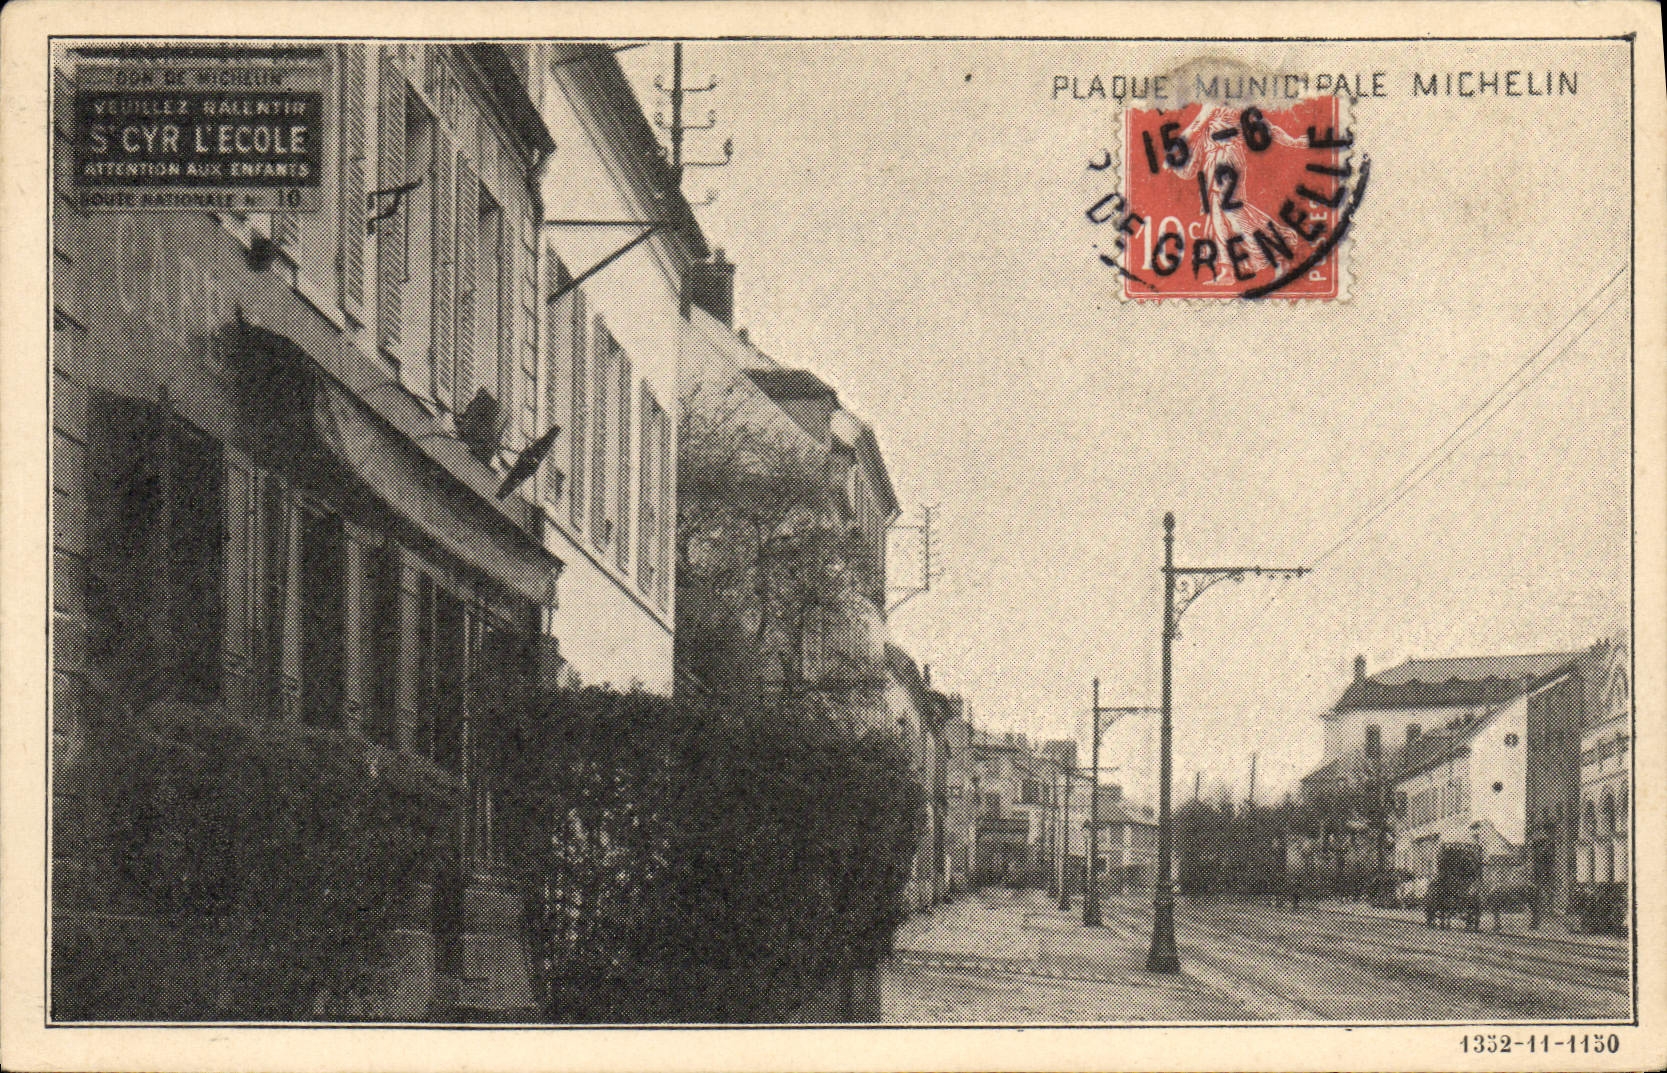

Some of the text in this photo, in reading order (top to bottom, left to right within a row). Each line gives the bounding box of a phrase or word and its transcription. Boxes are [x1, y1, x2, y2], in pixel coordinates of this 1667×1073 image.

[198, 70, 282, 86] MICHELIN
[93, 100, 306, 115] VEUILLEZ RALENTIR
[121, 124, 180, 154] CYR
[194, 124, 308, 154] L'ECOLE
[1141, 121, 1190, 174] 15
[83, 162, 310, 177] ATTENTION AUX ENFANTS
[141, 192, 236, 207] NATIONALE
[278, 189, 302, 208] 10
[1197, 163, 1244, 214] 12
[1151, 125, 1354, 281] GRENELLE
